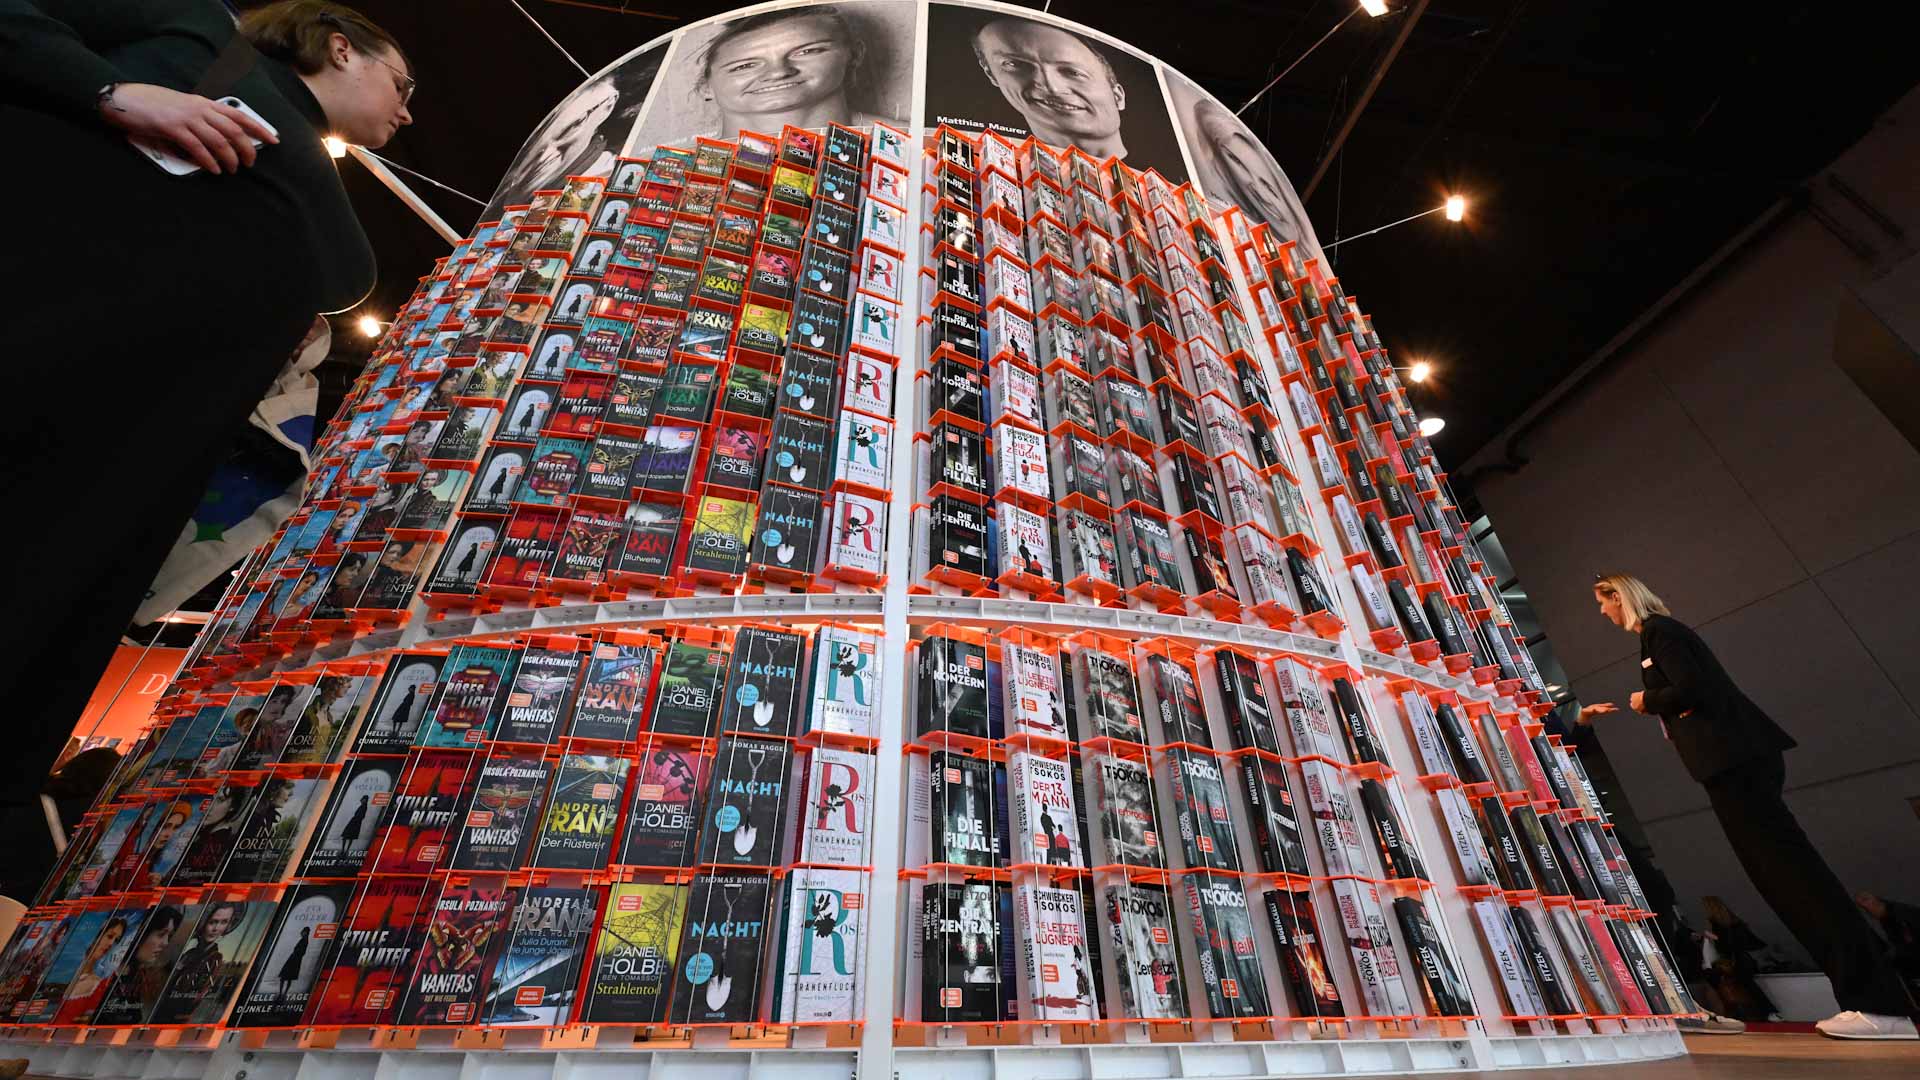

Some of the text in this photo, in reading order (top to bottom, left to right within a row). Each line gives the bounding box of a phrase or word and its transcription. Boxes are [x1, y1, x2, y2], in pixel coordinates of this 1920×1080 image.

[937, 116, 1027, 135] Matthias Maurer
[953, 279, 969, 290] DIE
[954, 313, 968, 323] DIE
[788, 370, 832, 385] NACHT
[942, 376, 982, 396] KONZERN
[954, 374, 971, 386] DER
[615, 404, 649, 417] VANITAS
[778, 436, 825, 453] NACHT
[713, 462, 758, 477] HOLBE
[720, 456, 752, 467] DANIEL
[955, 460, 976, 476] DIE
[591, 474, 626, 487] VANITAS
[943, 467, 987, 489] FILIALE
[764, 511, 814, 529] NACHT
[942, 513, 987, 533] ZENTRALE
[957, 511, 973, 520] DIE
[696, 538, 743, 551] HOLBE
[705, 531, 737, 541] DANIEL
[566, 553, 603, 567] VANITAS
[1300, 575, 1312, 594] FITZEK
[1466, 579, 1477, 596] FITZEK
[1369, 591, 1383, 610] FITZEK
[1407, 605, 1422, 624] FITZEK
[1443, 618, 1456, 637] FITZEK
[739, 661, 795, 680] NACHT
[949, 662, 970, 677] DER
[933, 669, 985, 690] KONZERN
[671, 685, 709, 697] DANIEL
[663, 693, 714, 707] HOLBE
[510, 708, 556, 723] VANITAS
[578, 711, 635, 726] Der Panther
[1349, 712, 1364, 738] FITZEK
[1417, 726, 1432, 750] FITZEK
[1460, 736, 1475, 759] FITZEK
[508, 768, 547, 780] POZNANSKI
[1104, 764, 1149, 785] TSOKOS
[1552, 766, 1566, 788] FITZEK
[719, 779, 781, 797] NACHT
[1032, 781, 1067, 797] DER 13.
[1580, 780, 1600, 809] FITZEK
[395, 796, 438, 808] STILLE
[552, 802, 616, 814] ANDREAS
[644, 802, 688, 815] DANIEL
[1031, 791, 1070, 809] MANN
[548, 810, 618, 834] FRANZ
[632, 813, 695, 830] HOLBE
[957, 816, 983, 835] DIE
[470, 828, 519, 845] VANITAS
[944, 832, 1000, 853] FILIALE
[1323, 821, 1337, 853] TSOKOS
[1382, 820, 1399, 849] FITZEK
[1455, 829, 1471, 857] FITZEK
[542, 837, 606, 850] Der Flüsterer
[1501, 836, 1518, 863] FITZEK
[304, 859, 336, 867] DUNKLE
[1538, 844, 1554, 870] FITZEK
[700, 876, 735, 884] THOMAS
[801, 877, 826, 887] Karen
[1625, 874, 1641, 897] FITZEK
[522, 896, 590, 909] ANDREAS
[1033, 888, 1074, 902] SCHWIECKER
[1200, 888, 1245, 908] TSOKOS
[438, 900, 506, 912] RSULA POZNANSKI
[1034, 901, 1076, 913] TSOKOS
[508, 905, 596, 932] FRANZ
[940, 918, 1000, 935] ZENTRALE
[691, 921, 762, 938] NACHT
[1047, 922, 1080, 934] LETZTE
[341, 930, 390, 945] STILLE
[519, 938, 539, 946] Julia
[1035, 932, 1084, 947] LÜGNERIN
[357, 948, 411, 966] BLUTET
[521, 946, 546, 955] junge
[613, 945, 657, 958] DANIEL
[601, 957, 668, 975] HOLBE
[1360, 950, 1377, 987] TSOKOS
[1419, 945, 1440, 980] FITZEK
[1499, 949, 1517, 981] FITZEK
[1534, 951, 1553, 982] FITZEK
[1580, 953, 1600, 983] FITZEK
[1635, 958, 1655, 988] FITZEK
[1669, 968, 1686, 994] FITZEK
[421, 974, 475, 993] VANITAS
[596, 982, 662, 995] Strahlentod
[285, 993, 309, 1001] TAGE
[236, 1004, 273, 1013] DUNKLE
